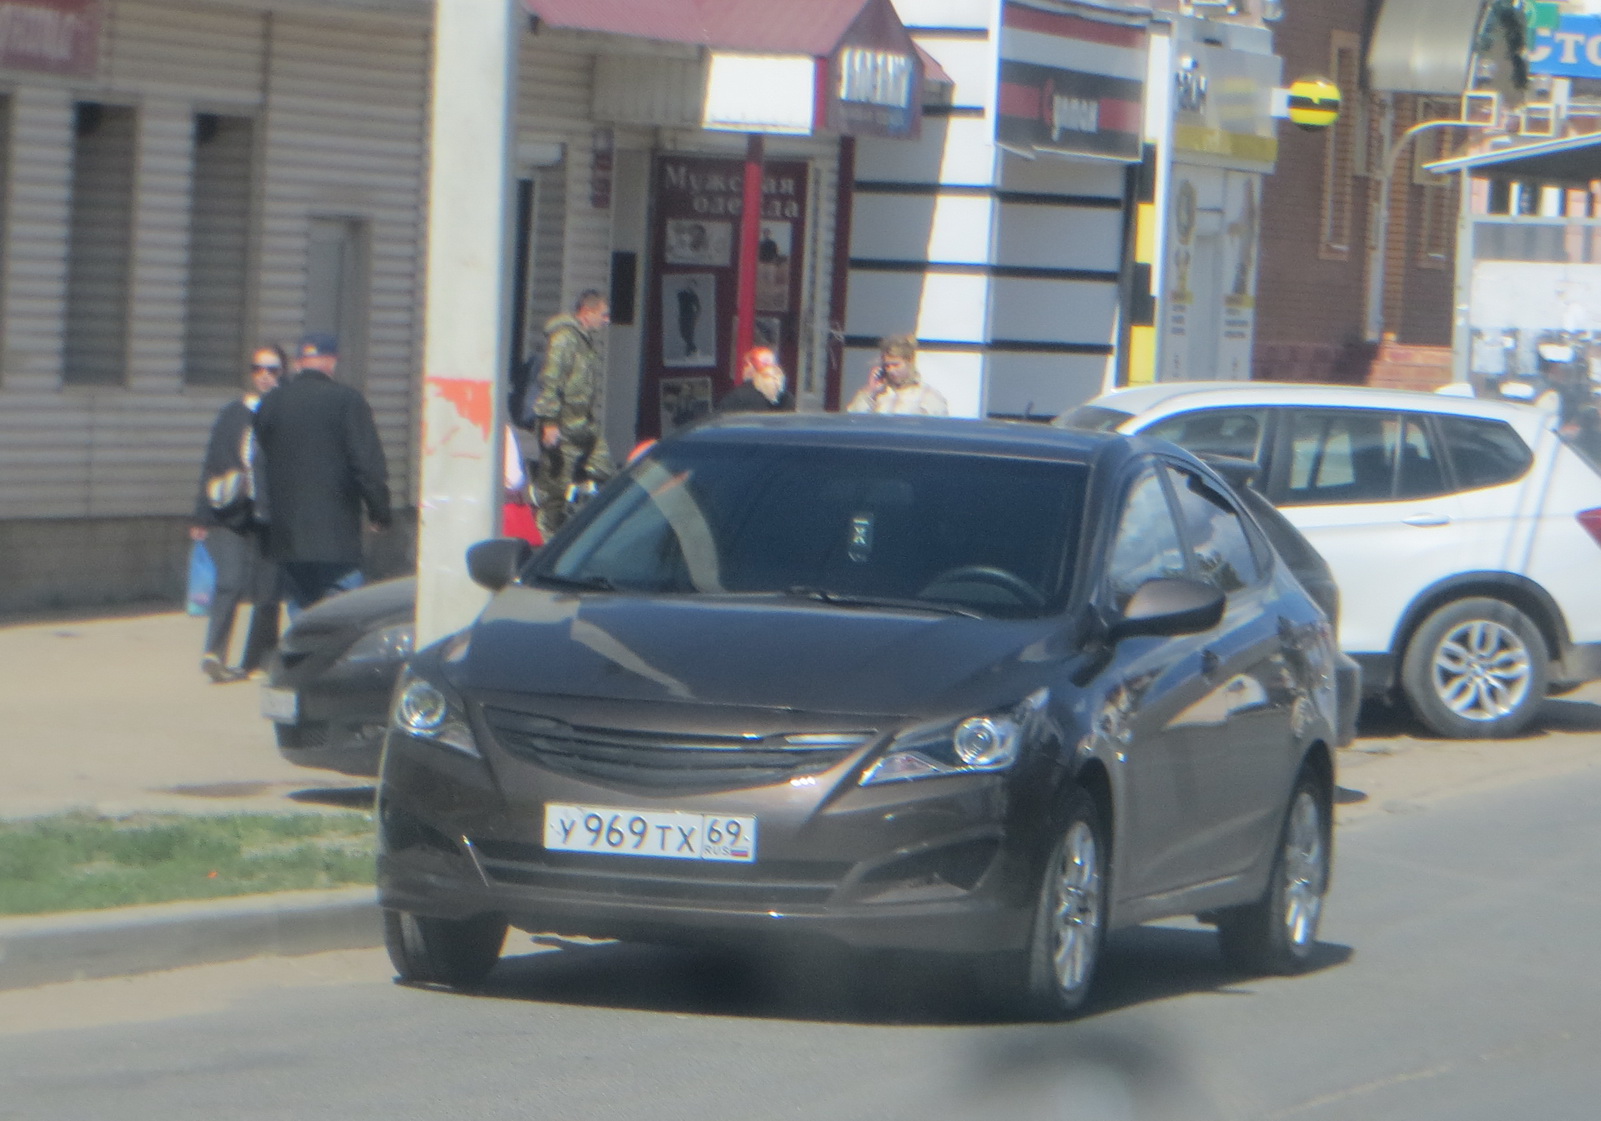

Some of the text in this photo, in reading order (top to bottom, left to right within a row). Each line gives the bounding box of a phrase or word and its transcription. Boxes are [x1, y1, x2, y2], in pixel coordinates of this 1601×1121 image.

[665, 163, 795, 195] Мужсая
[692, 196, 799, 219] одеда
[706, 817, 742, 846] 69
